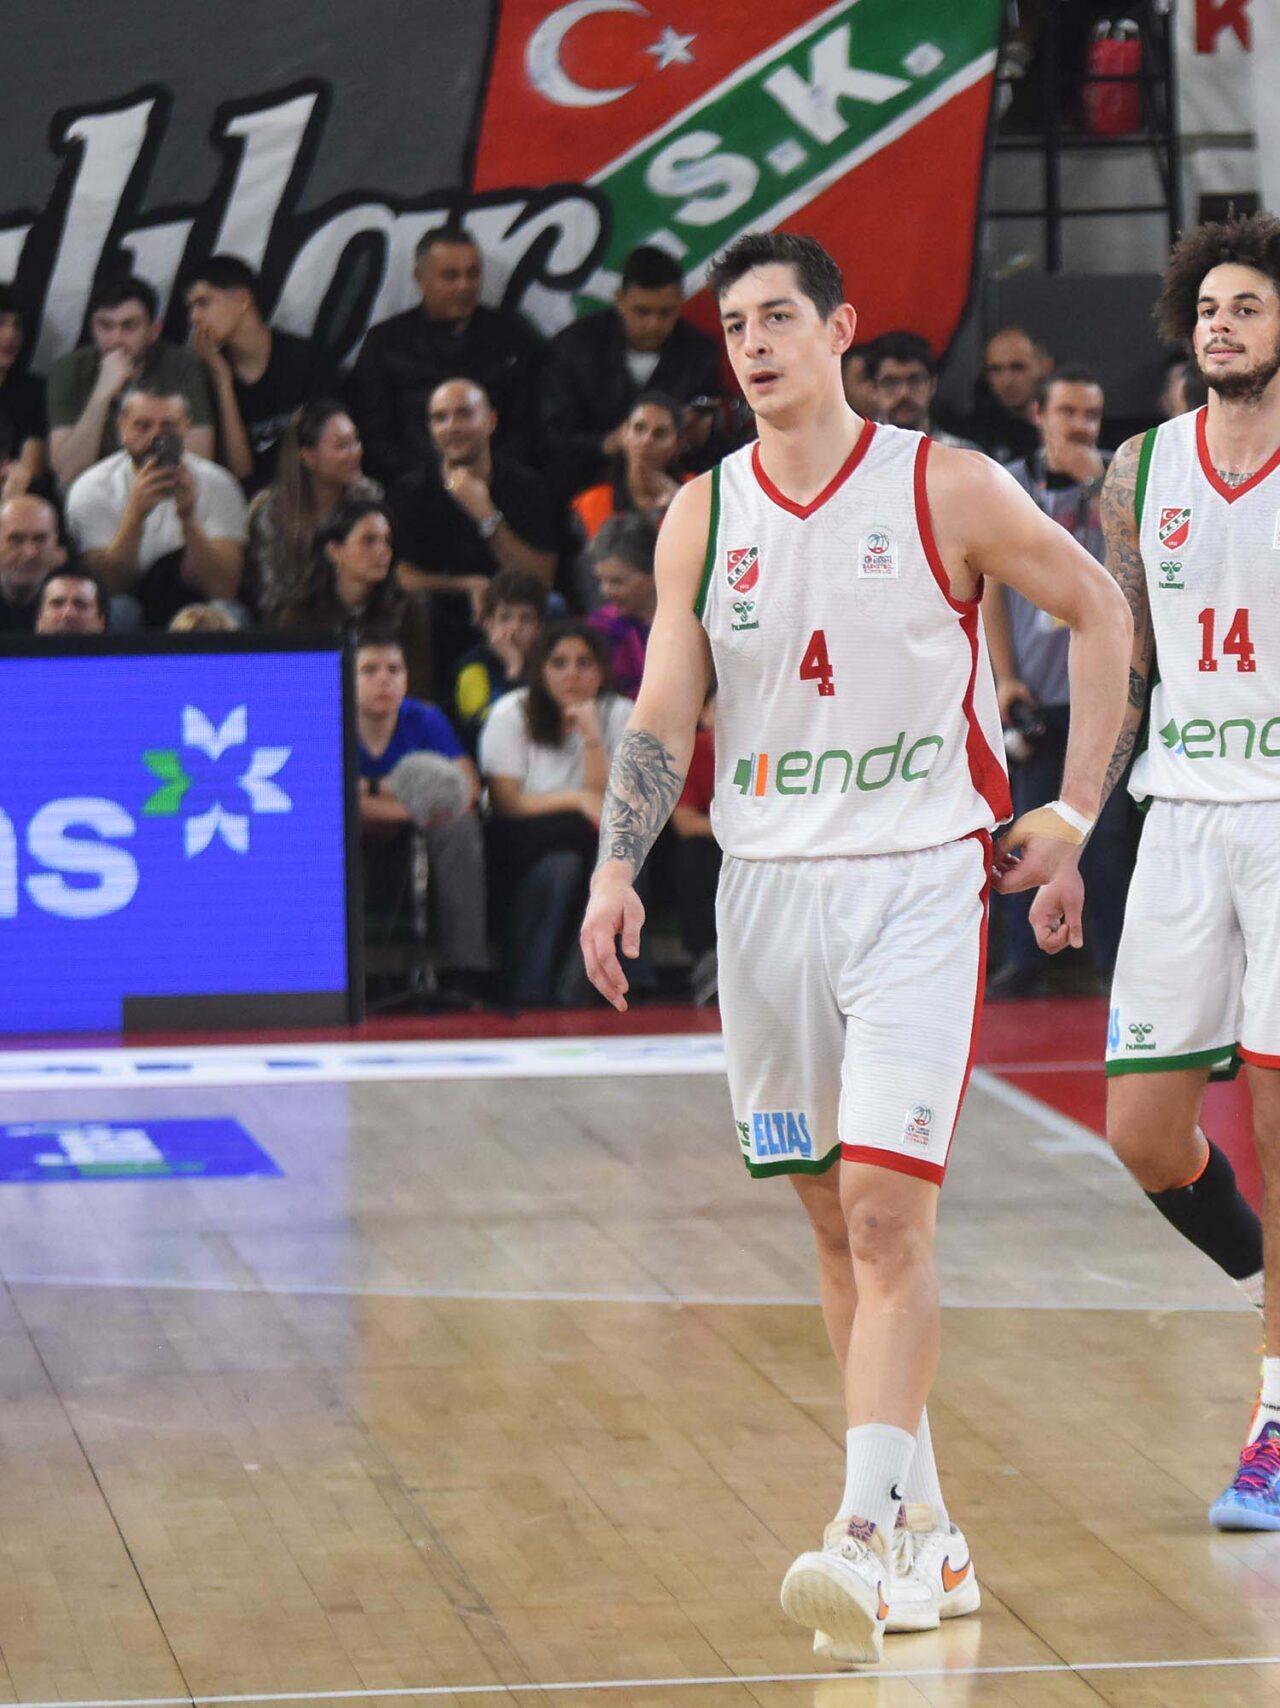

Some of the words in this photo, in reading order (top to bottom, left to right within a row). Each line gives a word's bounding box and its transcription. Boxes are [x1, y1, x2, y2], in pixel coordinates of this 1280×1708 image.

[800, 630, 835, 696] 4
[1198, 608, 1256, 672] 14
[1126, 1041, 1157, 1050] hummel
